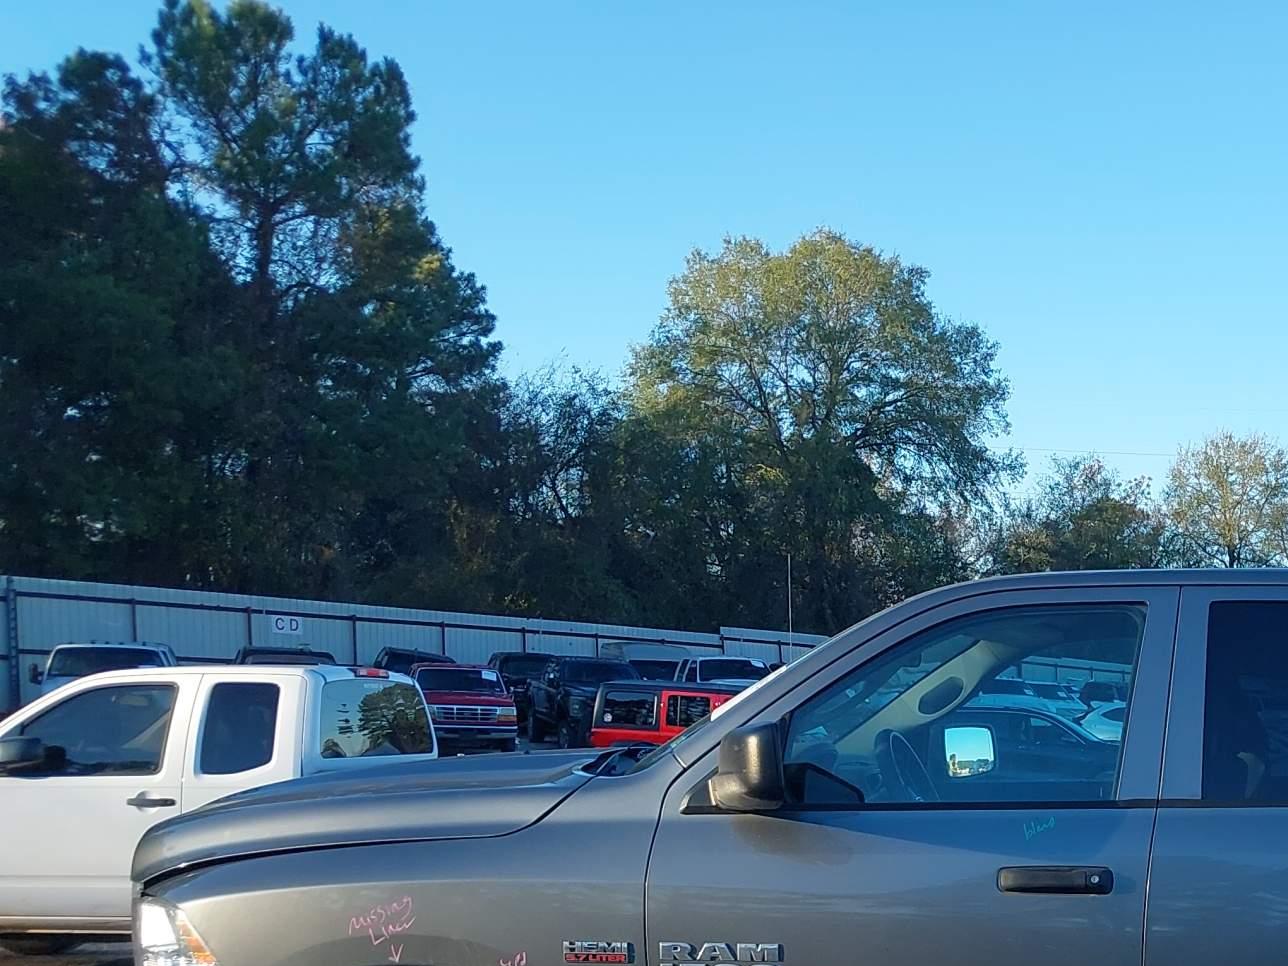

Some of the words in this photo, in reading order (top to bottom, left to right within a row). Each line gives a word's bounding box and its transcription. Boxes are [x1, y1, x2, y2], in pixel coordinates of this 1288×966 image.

[562, 941, 628, 953] HEMI
[659, 942, 781, 961] RAM
[588, 953, 626, 961] LITER
